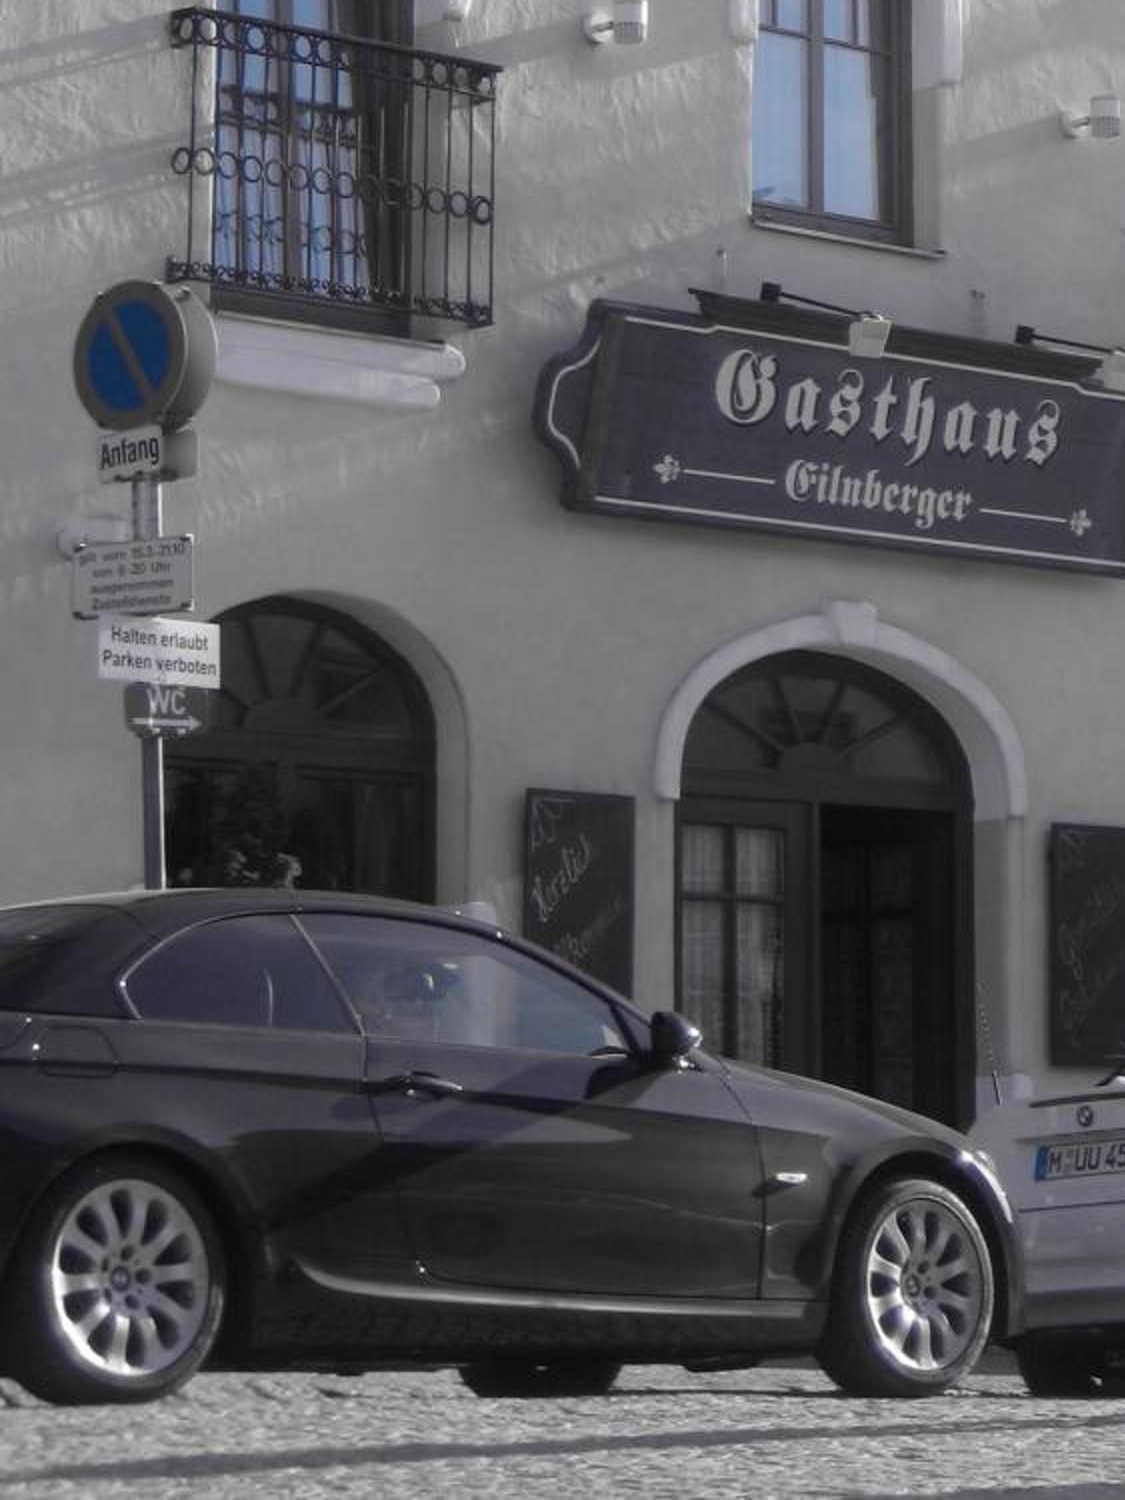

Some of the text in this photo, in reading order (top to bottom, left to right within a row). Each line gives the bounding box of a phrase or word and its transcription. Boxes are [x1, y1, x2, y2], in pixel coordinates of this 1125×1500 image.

[714, 348, 1062, 467] Gasthaus
[100, 437, 160, 470] Anfang
[111, 625, 209, 651] Halten erlaubt
[102, 649, 217, 676] Parken verboten
[145, 686, 186, 715] WC
[1048, 1148, 1063, 1174] M
